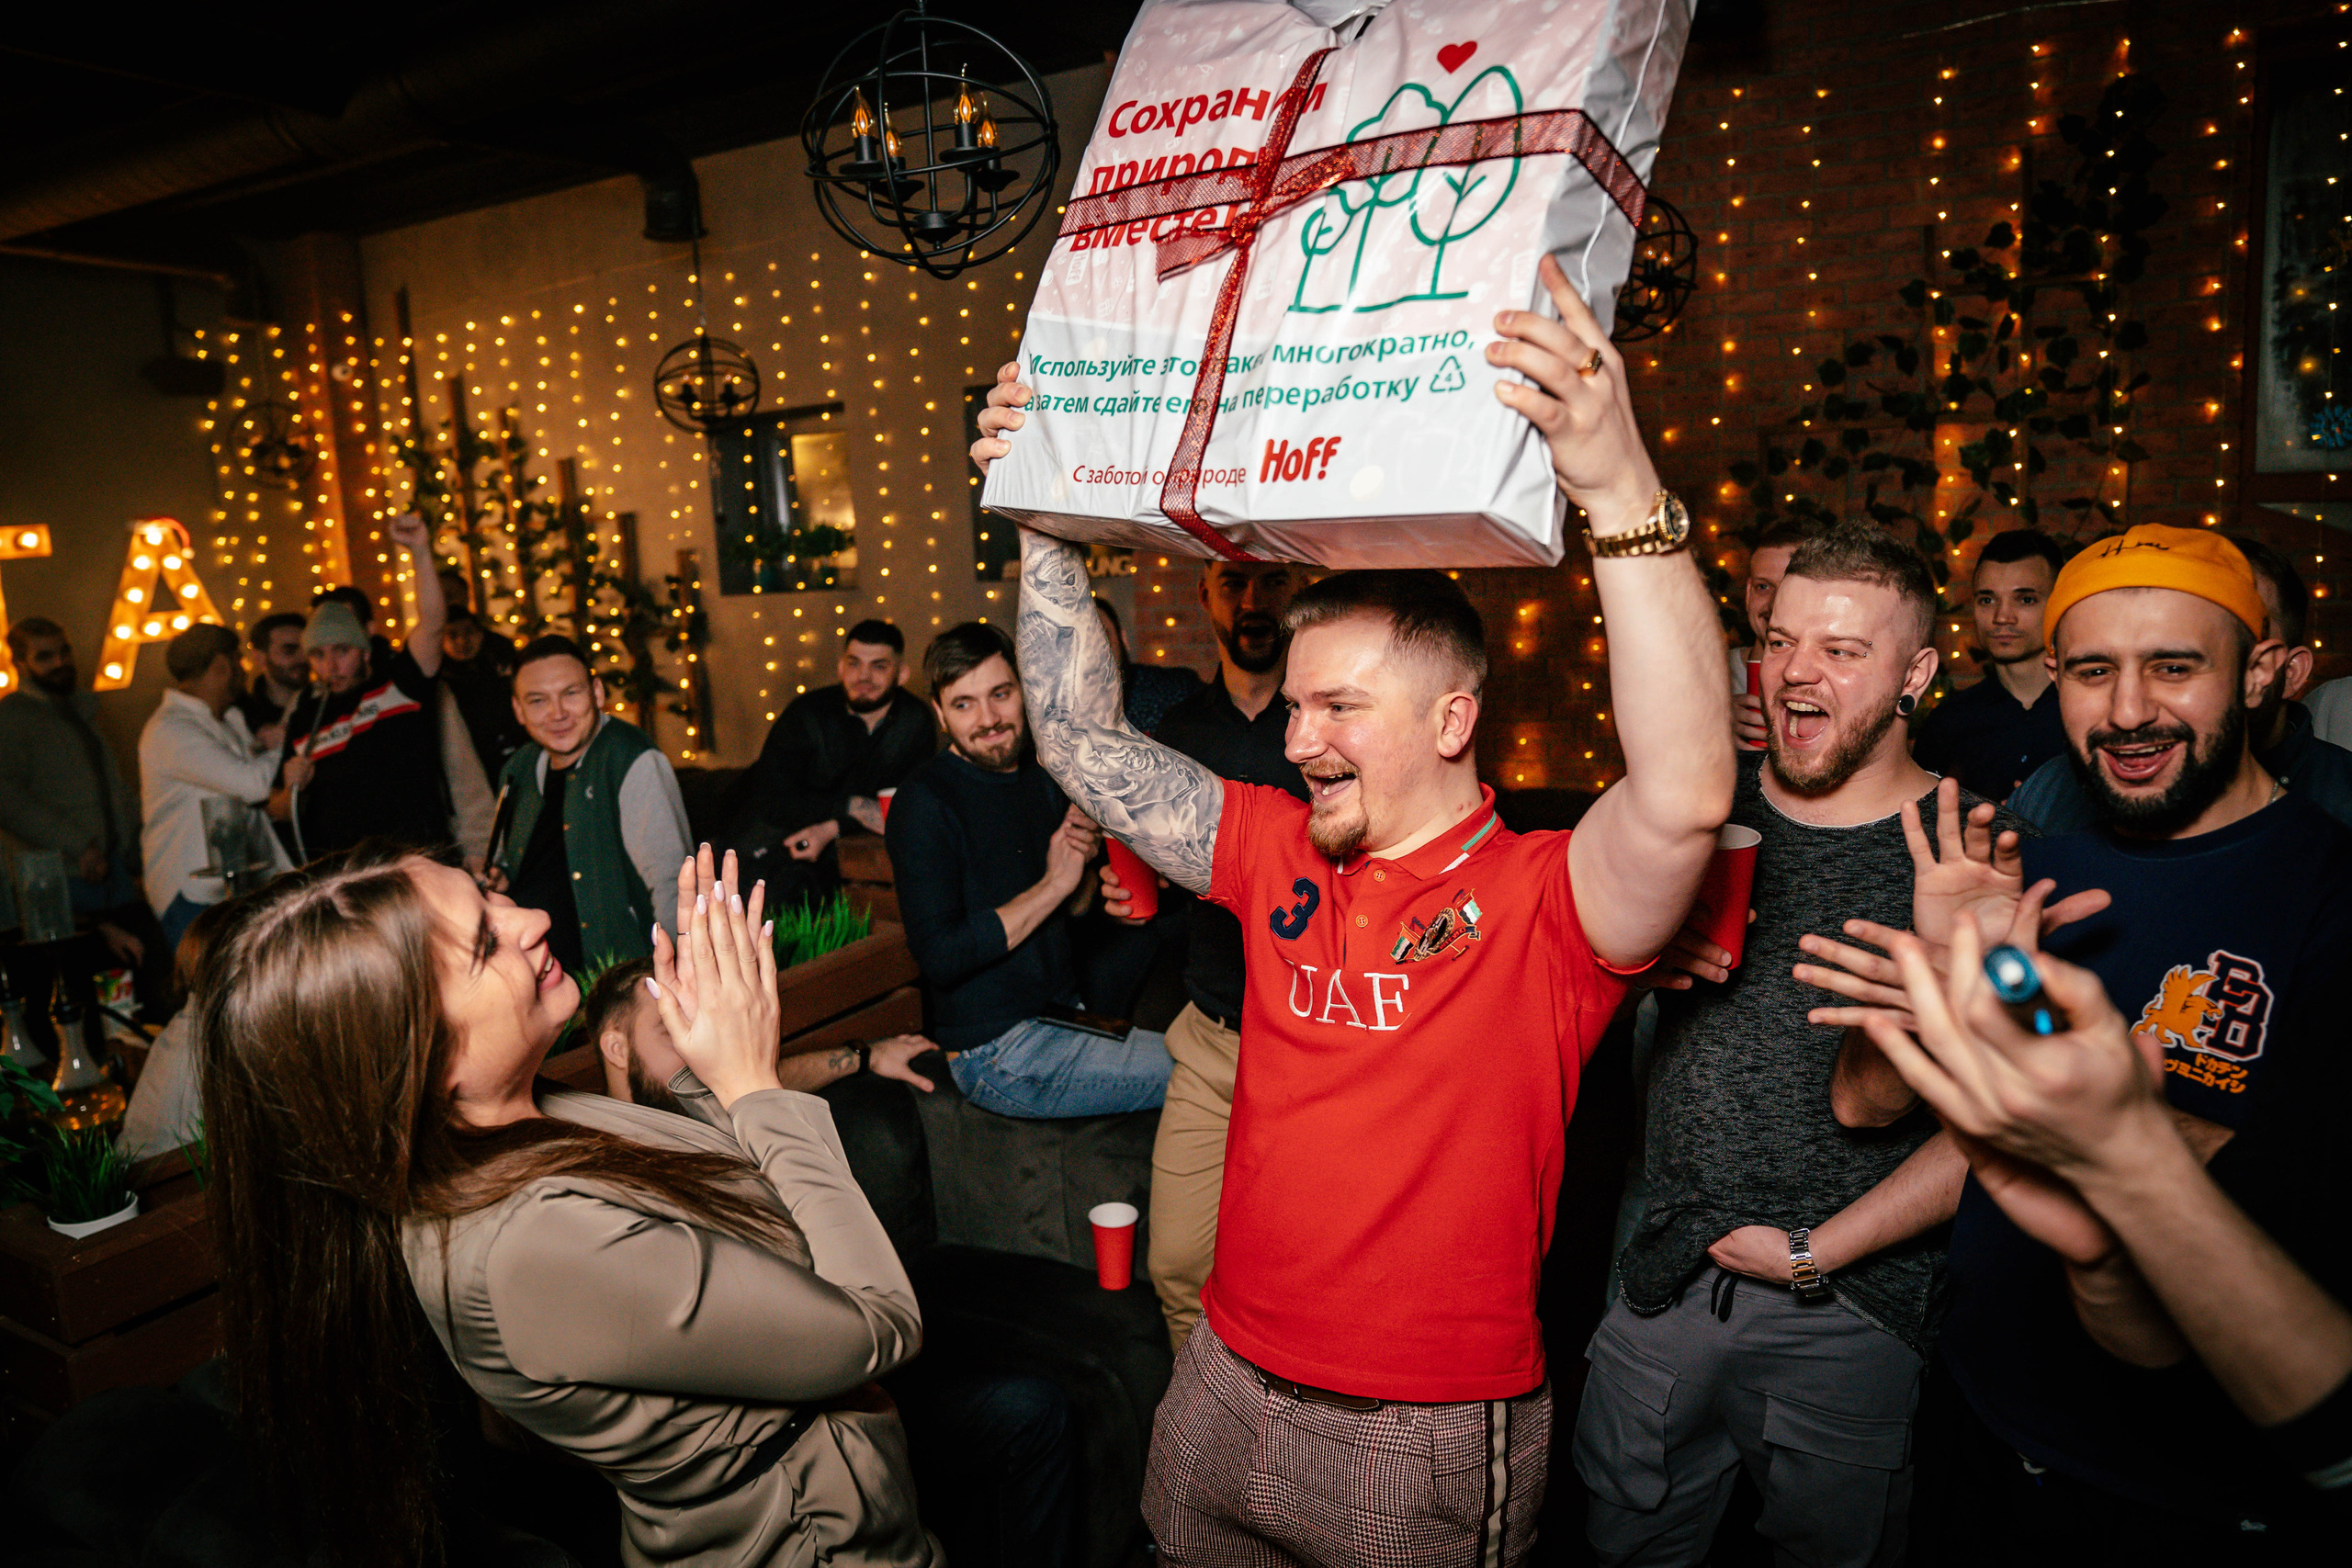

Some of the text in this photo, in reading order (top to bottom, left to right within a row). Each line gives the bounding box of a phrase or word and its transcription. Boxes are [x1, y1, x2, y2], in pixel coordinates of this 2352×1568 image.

[1030, 354, 1156, 382] Используйте
[1272, 330, 1475, 364] многократно,
[1036, 394, 1089, 413] затем
[1093, 390, 1161, 416] сдайте
[1242, 375, 1419, 412] переработку
[1073, 465, 1086, 483] С
[1270, 877, 1320, 941] 3
